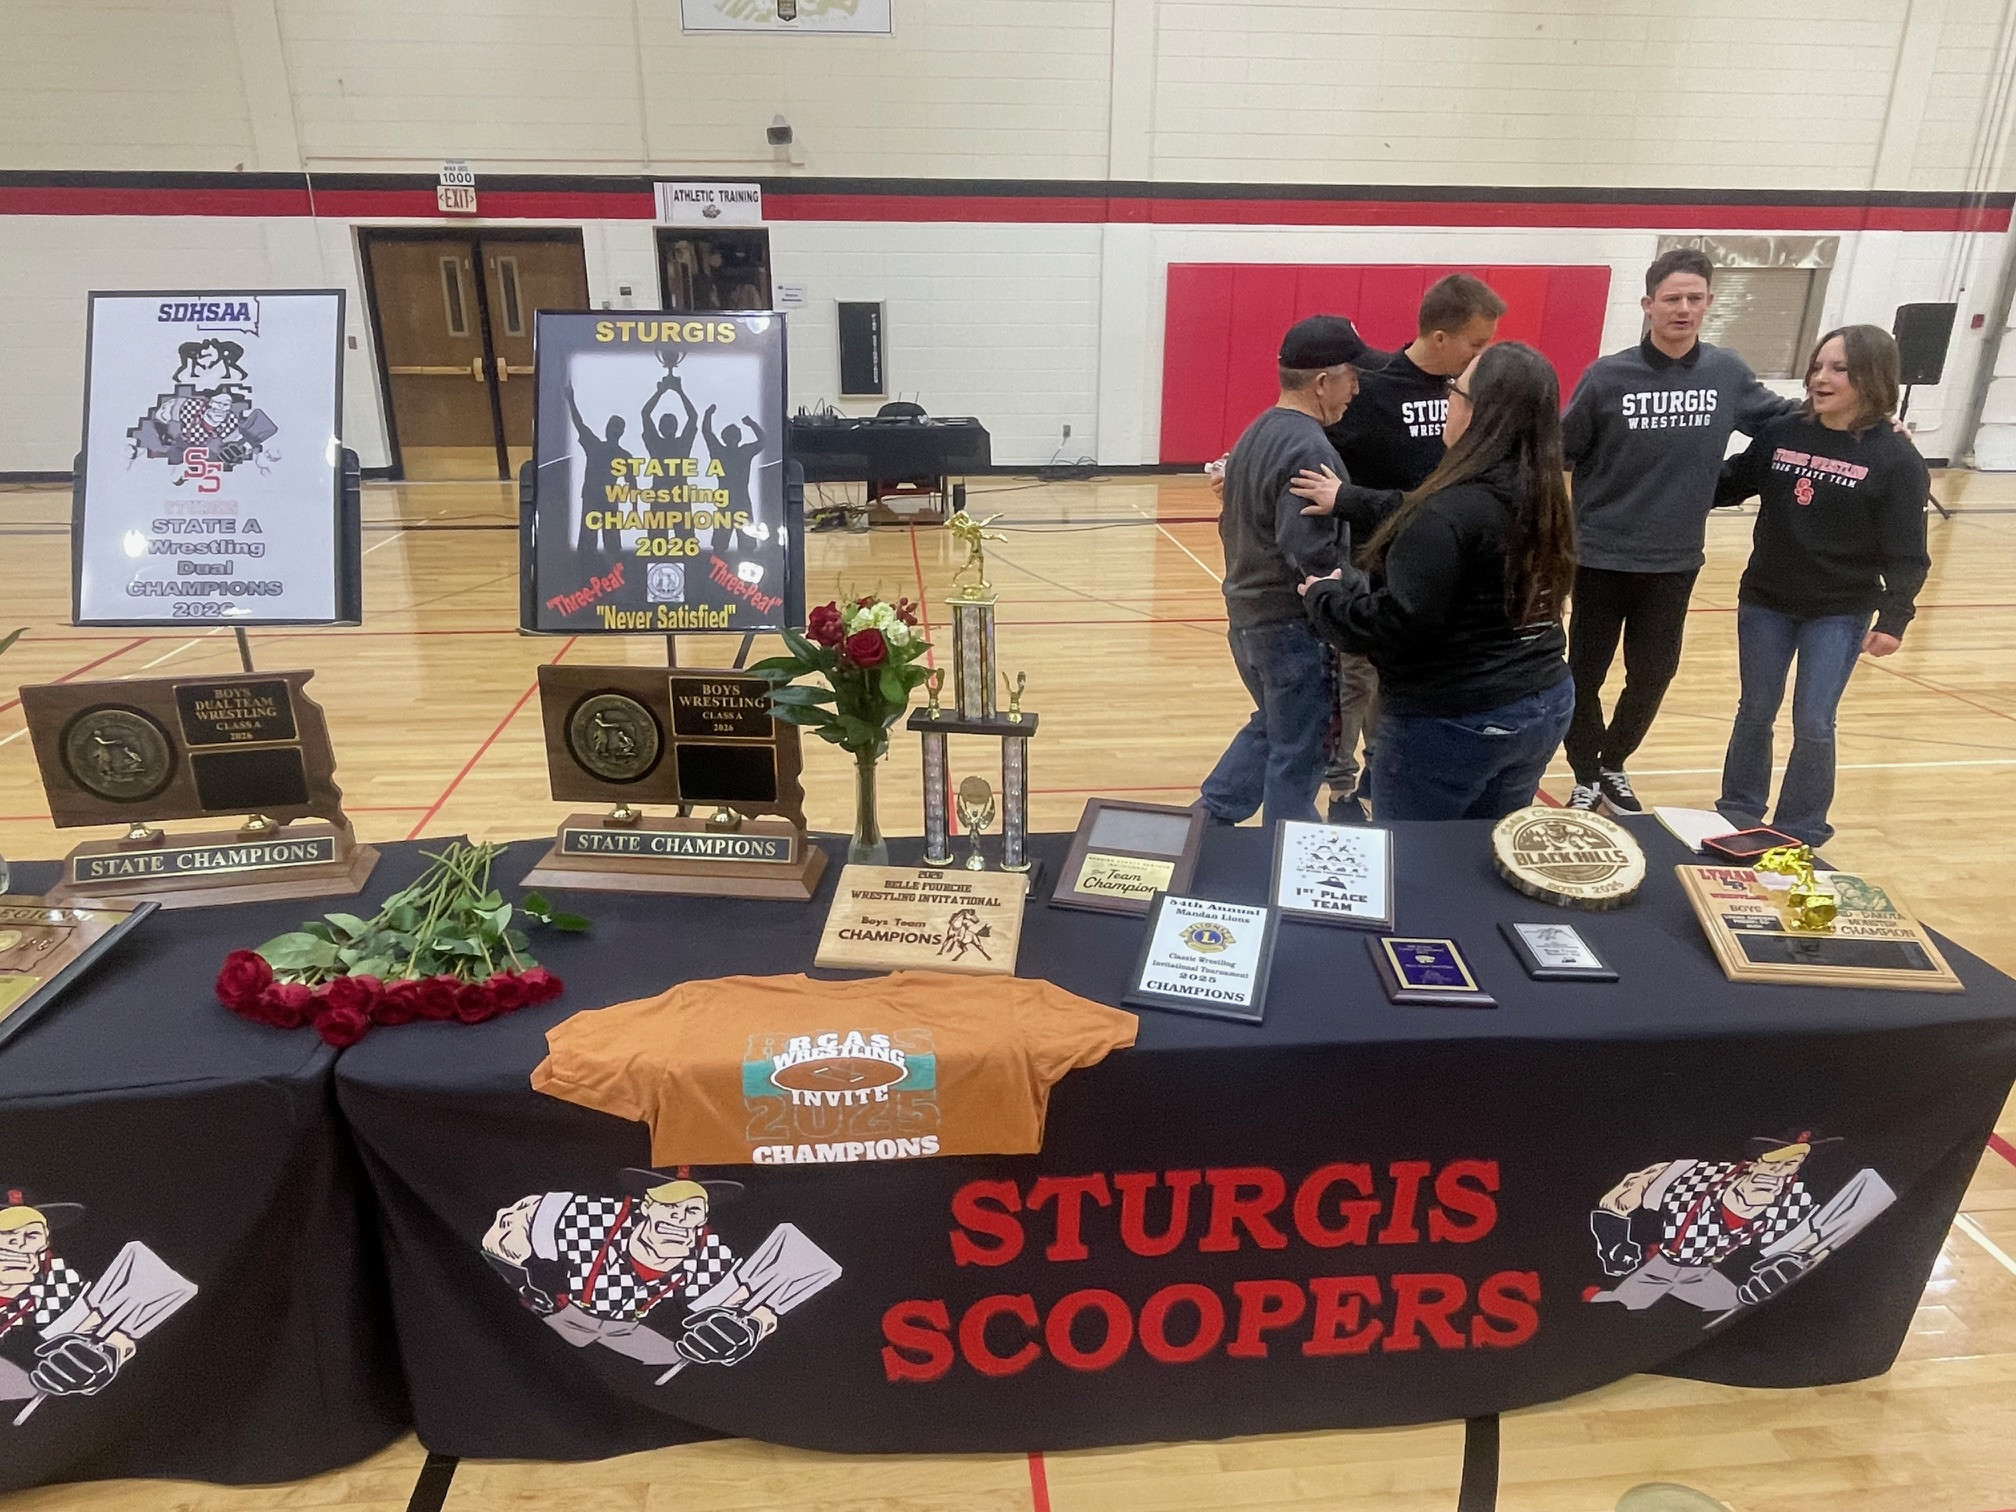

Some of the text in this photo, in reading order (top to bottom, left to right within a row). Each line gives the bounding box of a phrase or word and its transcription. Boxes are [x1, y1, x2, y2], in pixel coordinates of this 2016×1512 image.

[442, 172, 472, 183] 1000
[444, 188, 469, 208] EXIT
[673, 189, 759, 203] ATHLETIC TRAINING
[157, 302, 251, 322] SDHSAA
[595, 321, 737, 344] STURGIS
[1621, 389, 1718, 416] STURGIS
[1628, 414, 1711, 430] WRESTLING
[610, 458, 726, 478] STATE A
[1794, 466, 1826, 481] STATE
[1829, 474, 1858, 488] TEAM
[604, 484, 730, 508] Wrestling
[152, 518, 263, 534] STATE A
[585, 510, 750, 531] CHAMPIONS
[148, 539, 266, 559] Wrestling
[635, 538, 700, 557] 2026
[177, 560, 234, 576] Dual
[126, 581, 284, 597] CHAMPIONS
[214, 687, 251, 699] BOYS
[702, 684, 740, 696] BOYS
[195, 697, 274, 711] DUAL TEAM
[678, 696, 765, 709] WRESTLING
[194, 707, 277, 720] WRESTLING
[702, 711, 743, 720] CLASS A
[216, 720, 261, 731] CLASS A
[713, 723, 734, 732] 2026
[578, 834, 776, 857] STATE CHAMPIONS
[90, 842, 319, 877] STATE CHAMPIONS
[1512, 849, 1630, 866] BLACK HILLS
[917, 870, 944, 880] 2026
[1106, 868, 1142, 882] Team
[884, 880, 973, 893] BELLE FOURCHE
[851, 890, 1001, 907] WRESTLING INVITATIONAL
[1311, 898, 1352, 912] TEAM
[1321, 890, 1368, 903] PLACE
[1169, 899, 1261, 916] 54th Annual
[1175, 908, 1251, 924] Mandan Lions
[861, 916, 926, 928] Boys Team
[838, 928, 942, 946] CHAMPIONS
[1201, 931, 1215, 943] L
[1841, 925, 1916, 938] CHAMPION
[1152, 959, 1249, 979] Invitational Tournament
[1168, 952, 1237, 969] Classic Wrestling
[1178, 972, 1217, 984] 2025
[1146, 980, 1246, 1003] CHAMPIONS
[787, 1030, 891, 1051] RCAS
[772, 1046, 906, 1071] WRESTLING
[791, 1085, 889, 1108] INVITE
[752, 1134, 940, 1165] CHAMPIONS
[949, 1159, 1500, 1267] STURGIS
[880, 1270, 1542, 1383] SCOOPERS
